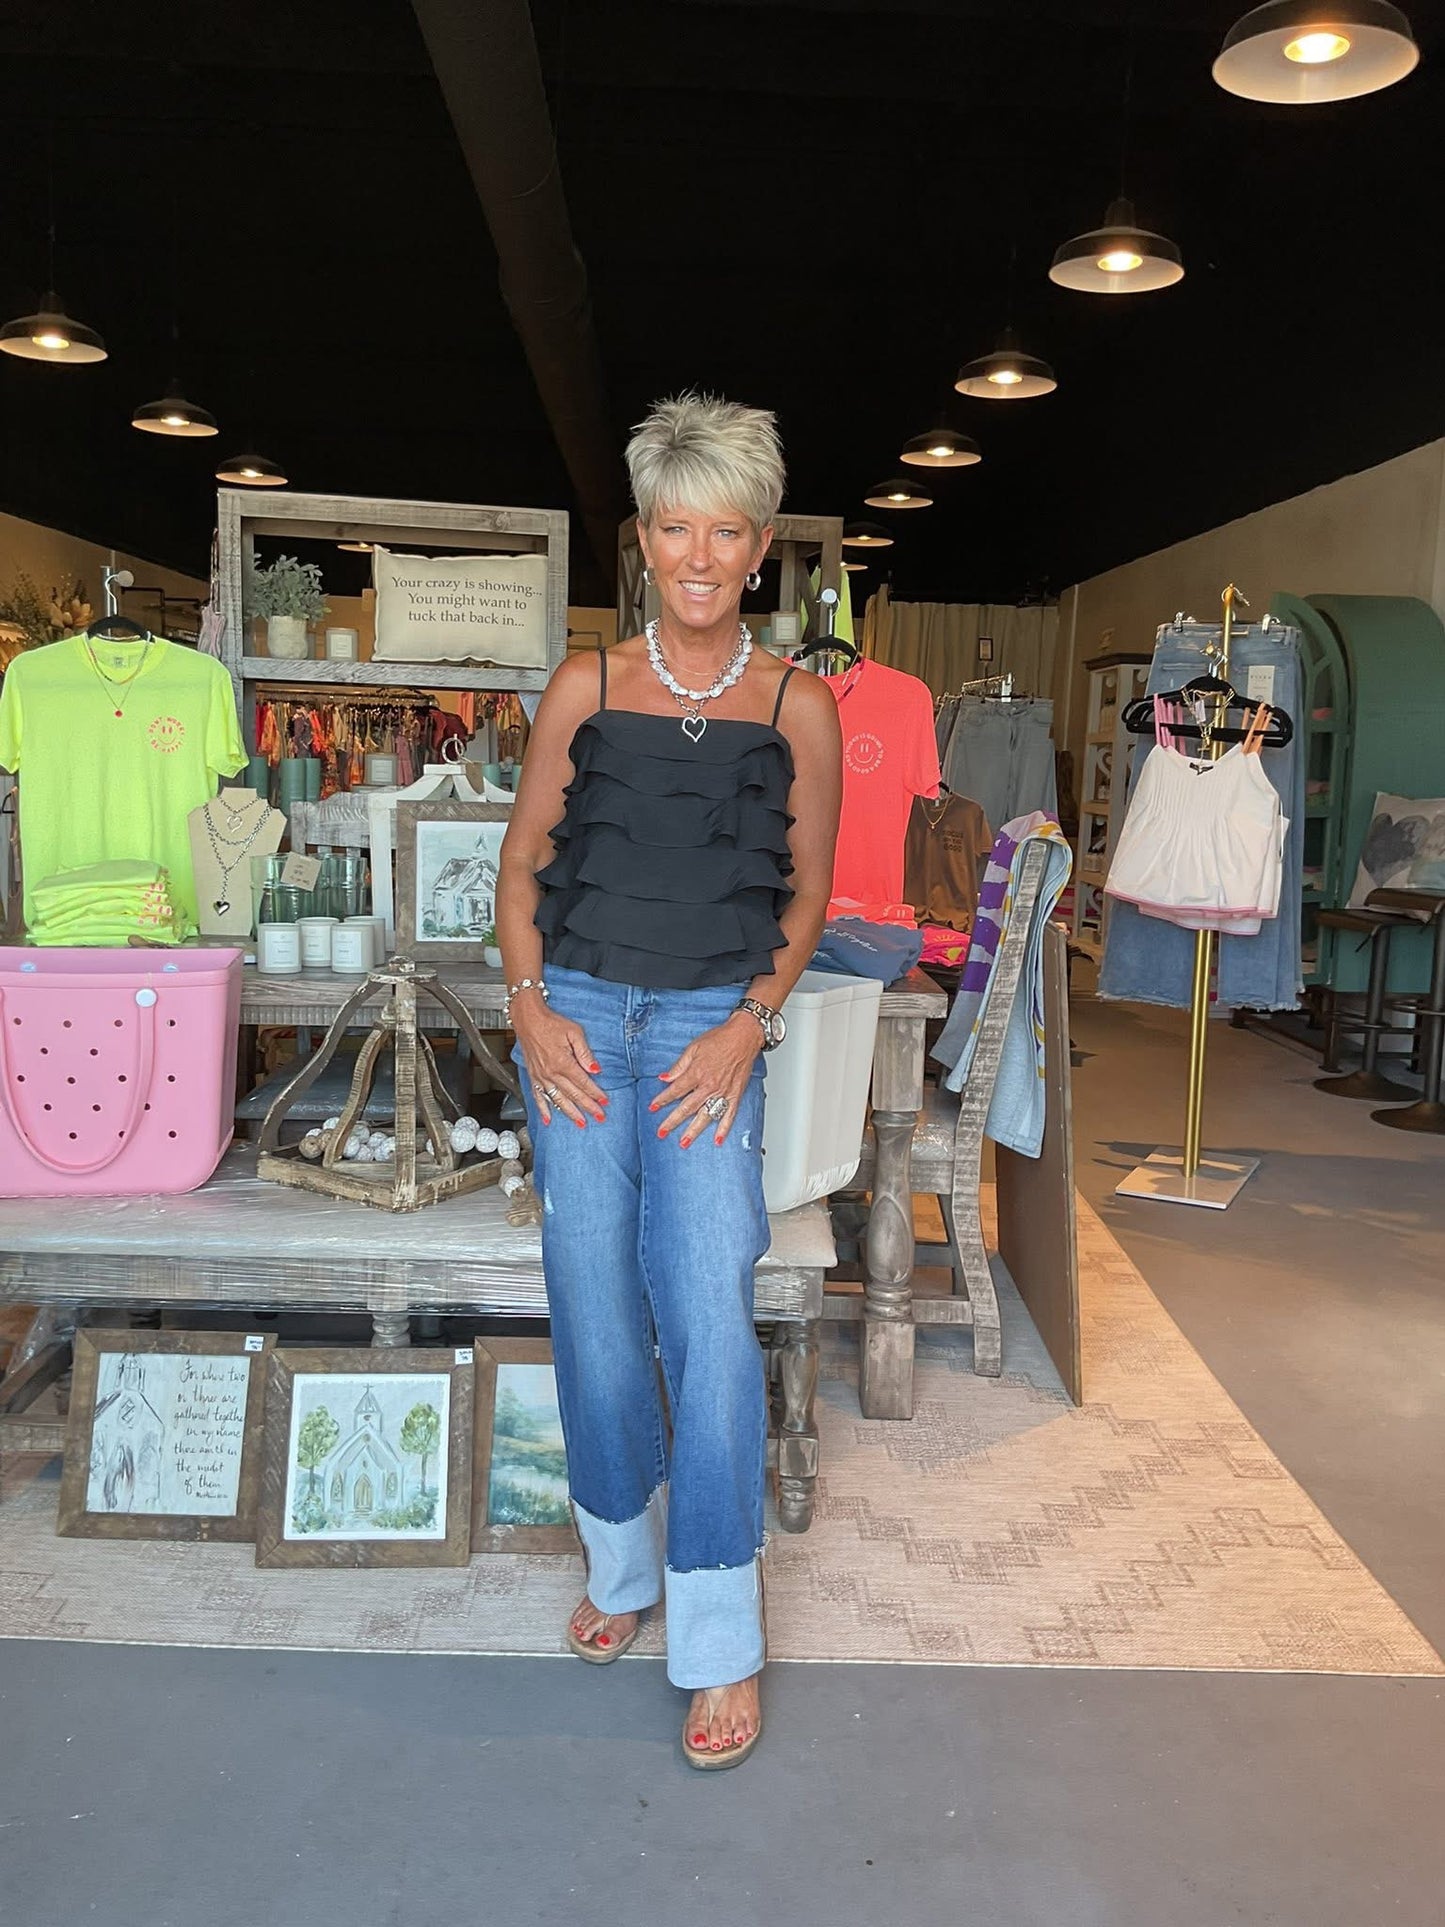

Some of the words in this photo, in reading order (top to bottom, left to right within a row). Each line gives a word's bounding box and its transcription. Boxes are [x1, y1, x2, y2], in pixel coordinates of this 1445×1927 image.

[392, 576, 422, 588] Your
[425, 579, 460, 592] crazy
[465, 578, 475, 589] is
[478, 579, 542, 598] showing...
[408, 592, 433, 604] You
[437, 593, 475, 609] might
[479, 598, 510, 609] want
[515, 599, 527, 610] to
[408, 609, 437, 622] tuck
[440, 610, 465, 622] that
[469, 611, 499, 625] back
[502, 614, 525, 627] in...
[228, 1366, 245, 1382] two
[175, 1459, 191, 1472] the
